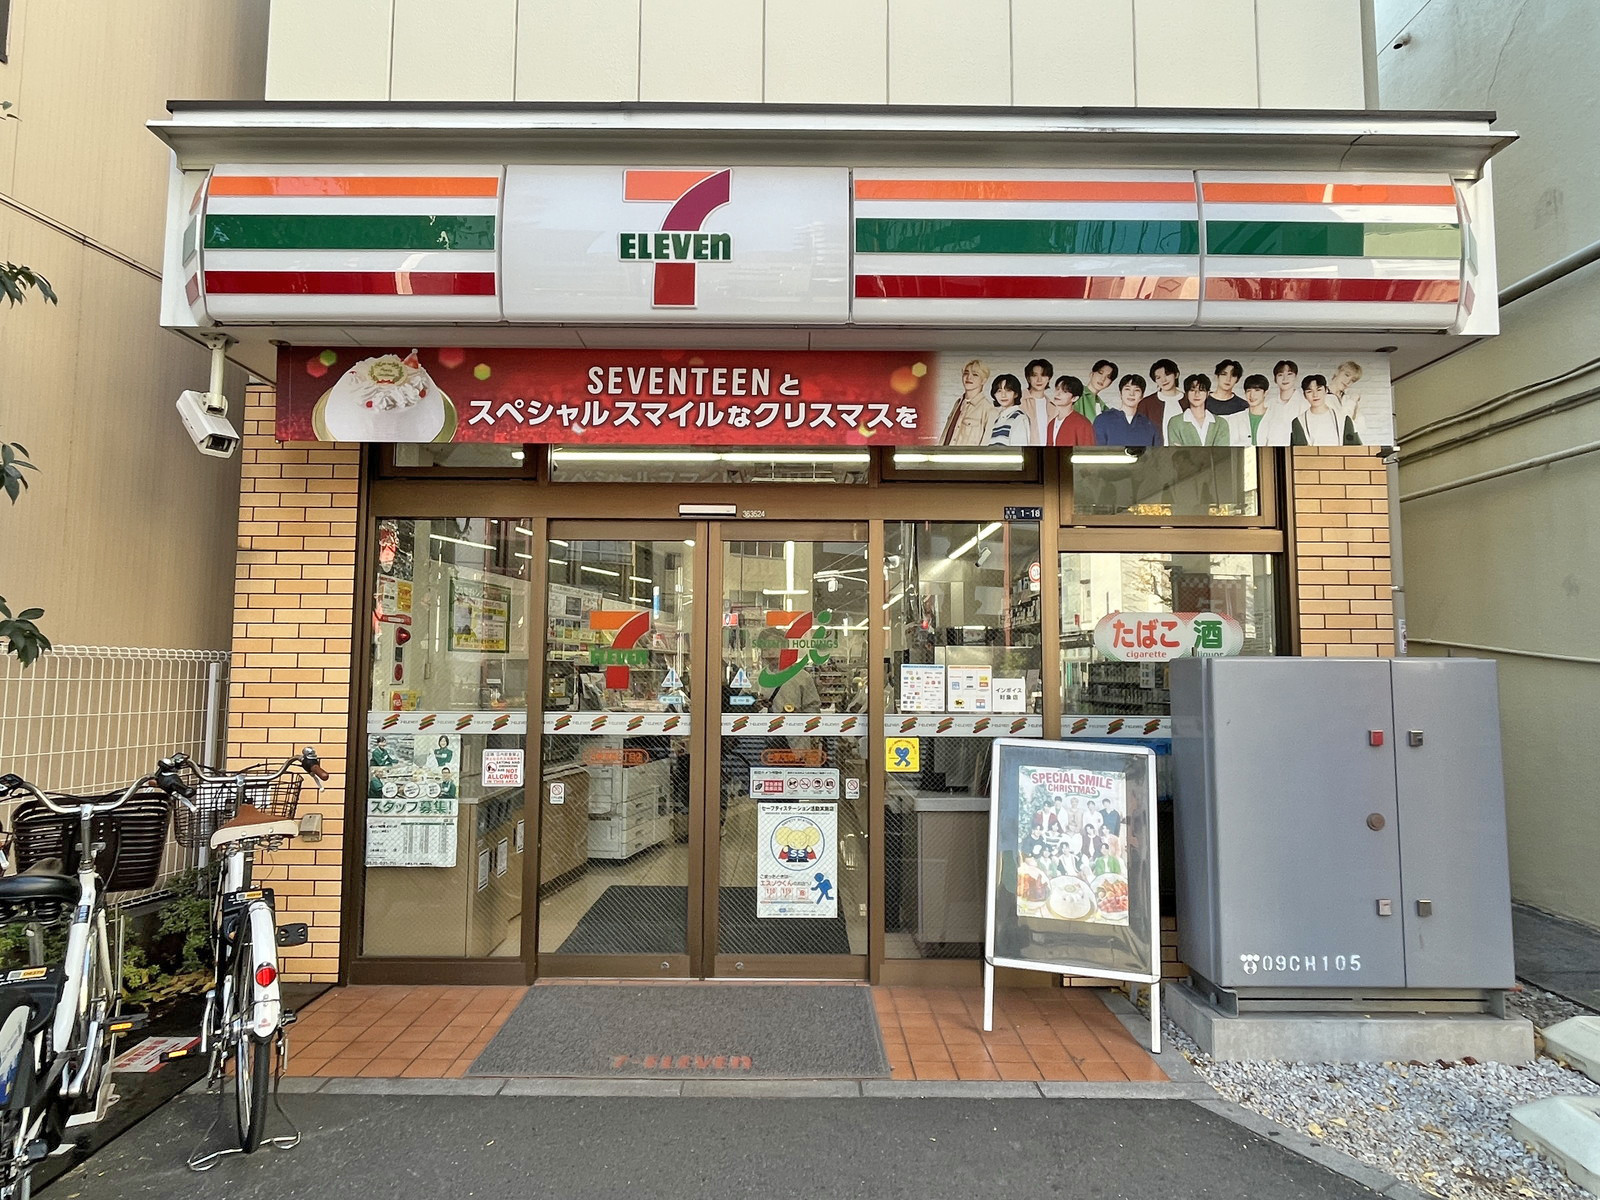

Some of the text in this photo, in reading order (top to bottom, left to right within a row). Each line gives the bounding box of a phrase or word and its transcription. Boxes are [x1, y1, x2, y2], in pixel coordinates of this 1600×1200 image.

[587, 366, 770, 396] SEVENTEEN
[468, 398, 918, 429] スペシャルスマイルなクリスマスを
[1112, 619, 1223, 648] たばこ 酒
[1126, 651, 1167, 659] cigarette
[1031, 772, 1113, 790] SPECIAL SMILE
[1048, 783, 1096, 795] CHRISTMAS
[1262, 954, 1361, 972] 09CH105
